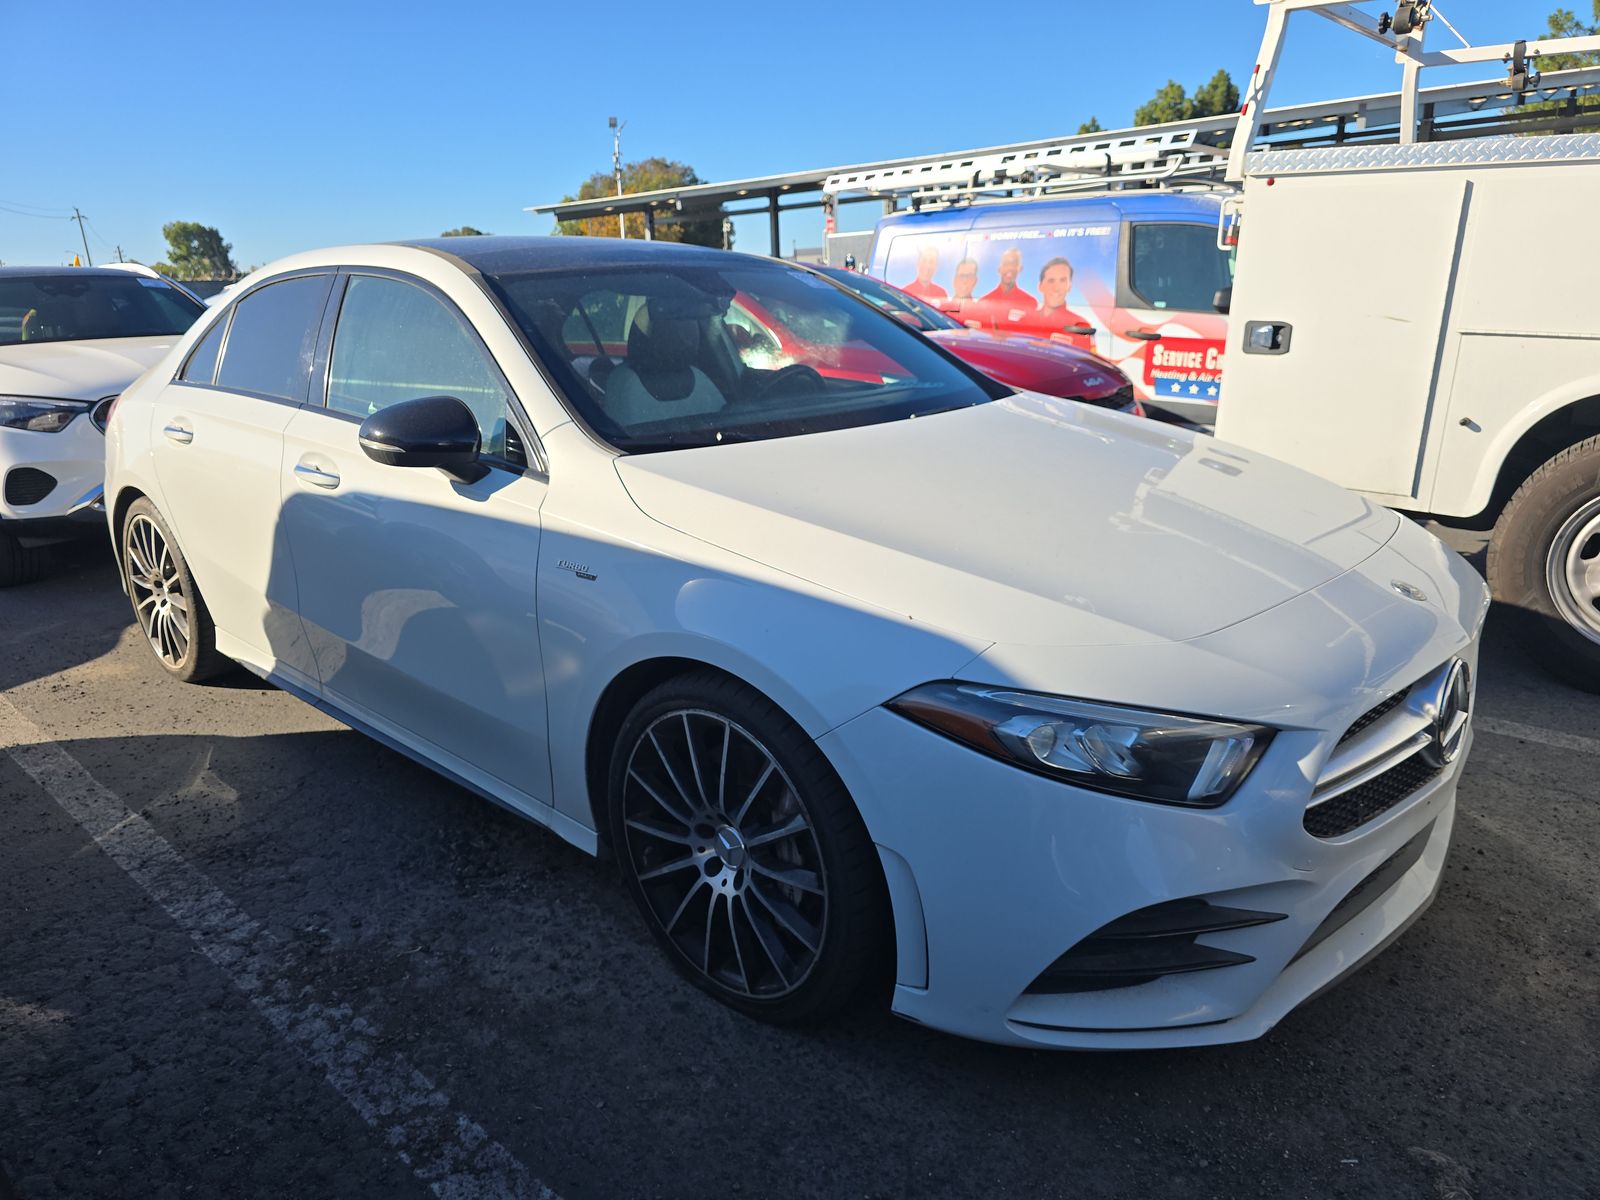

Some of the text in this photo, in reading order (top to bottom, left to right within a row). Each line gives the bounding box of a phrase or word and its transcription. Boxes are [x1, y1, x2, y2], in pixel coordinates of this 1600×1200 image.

[1152, 344, 1203, 368] SERVICE
[1150, 368, 1187, 382] Heating
[1188, 371, 1198, 381] &
[1197, 372, 1214, 382] Air
[557, 559, 590, 573] TURBO
